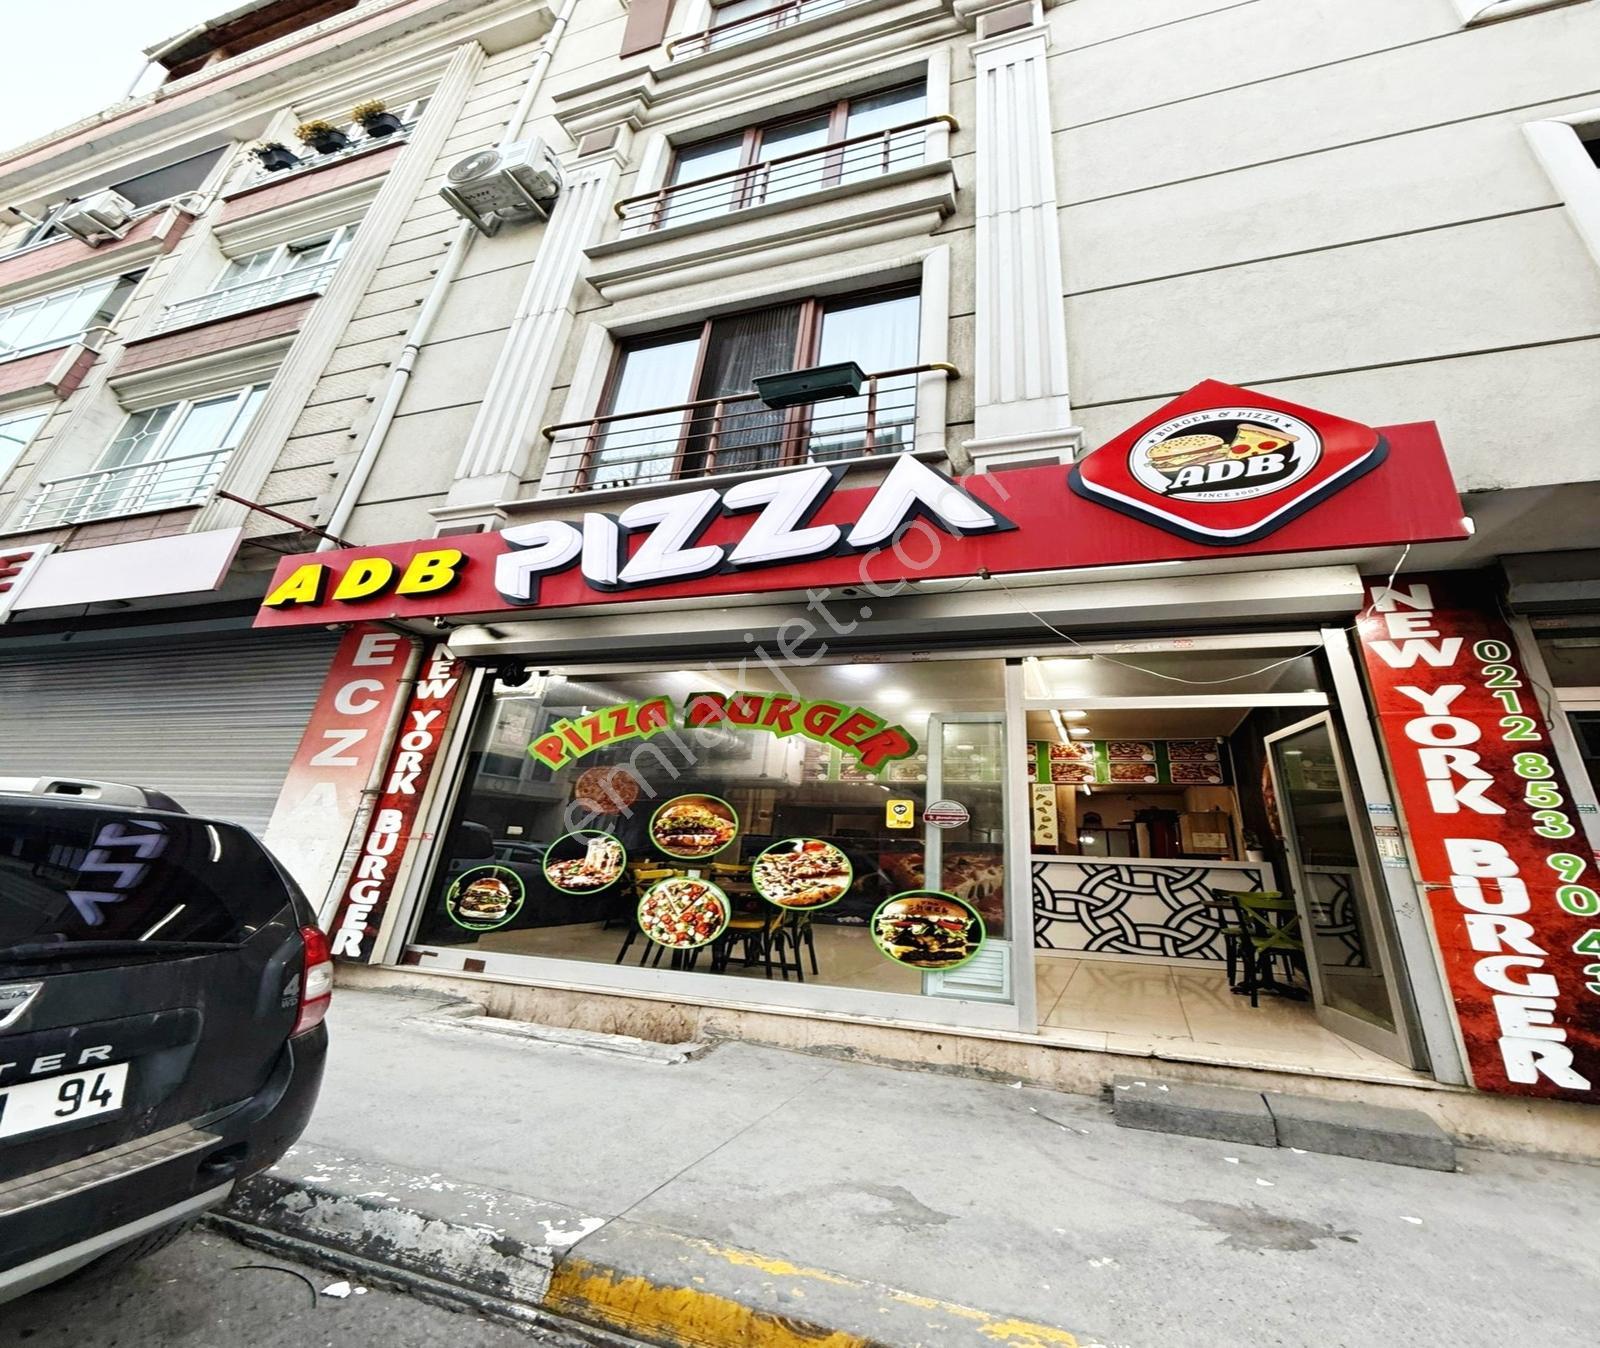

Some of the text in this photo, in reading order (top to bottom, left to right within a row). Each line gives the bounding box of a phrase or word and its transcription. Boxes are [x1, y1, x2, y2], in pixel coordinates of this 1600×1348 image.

[1155, 413, 1211, 438] BURGER
[1217, 411, 1231, 419] &
[1169, 452, 1286, 491] ADB
[263, 453, 1000, 608] ADB PIZZA
[386, 710, 442, 795] YORK
[685, 692, 913, 770] BURGER
[1473, 639, 1542, 741] 0212
[1512, 752, 1576, 839] 853
[1367, 583, 1592, 1090] NEW YORK BURGER
[330, 809, 404, 958] BURGER
[54, 1073, 113, 1117] 94
